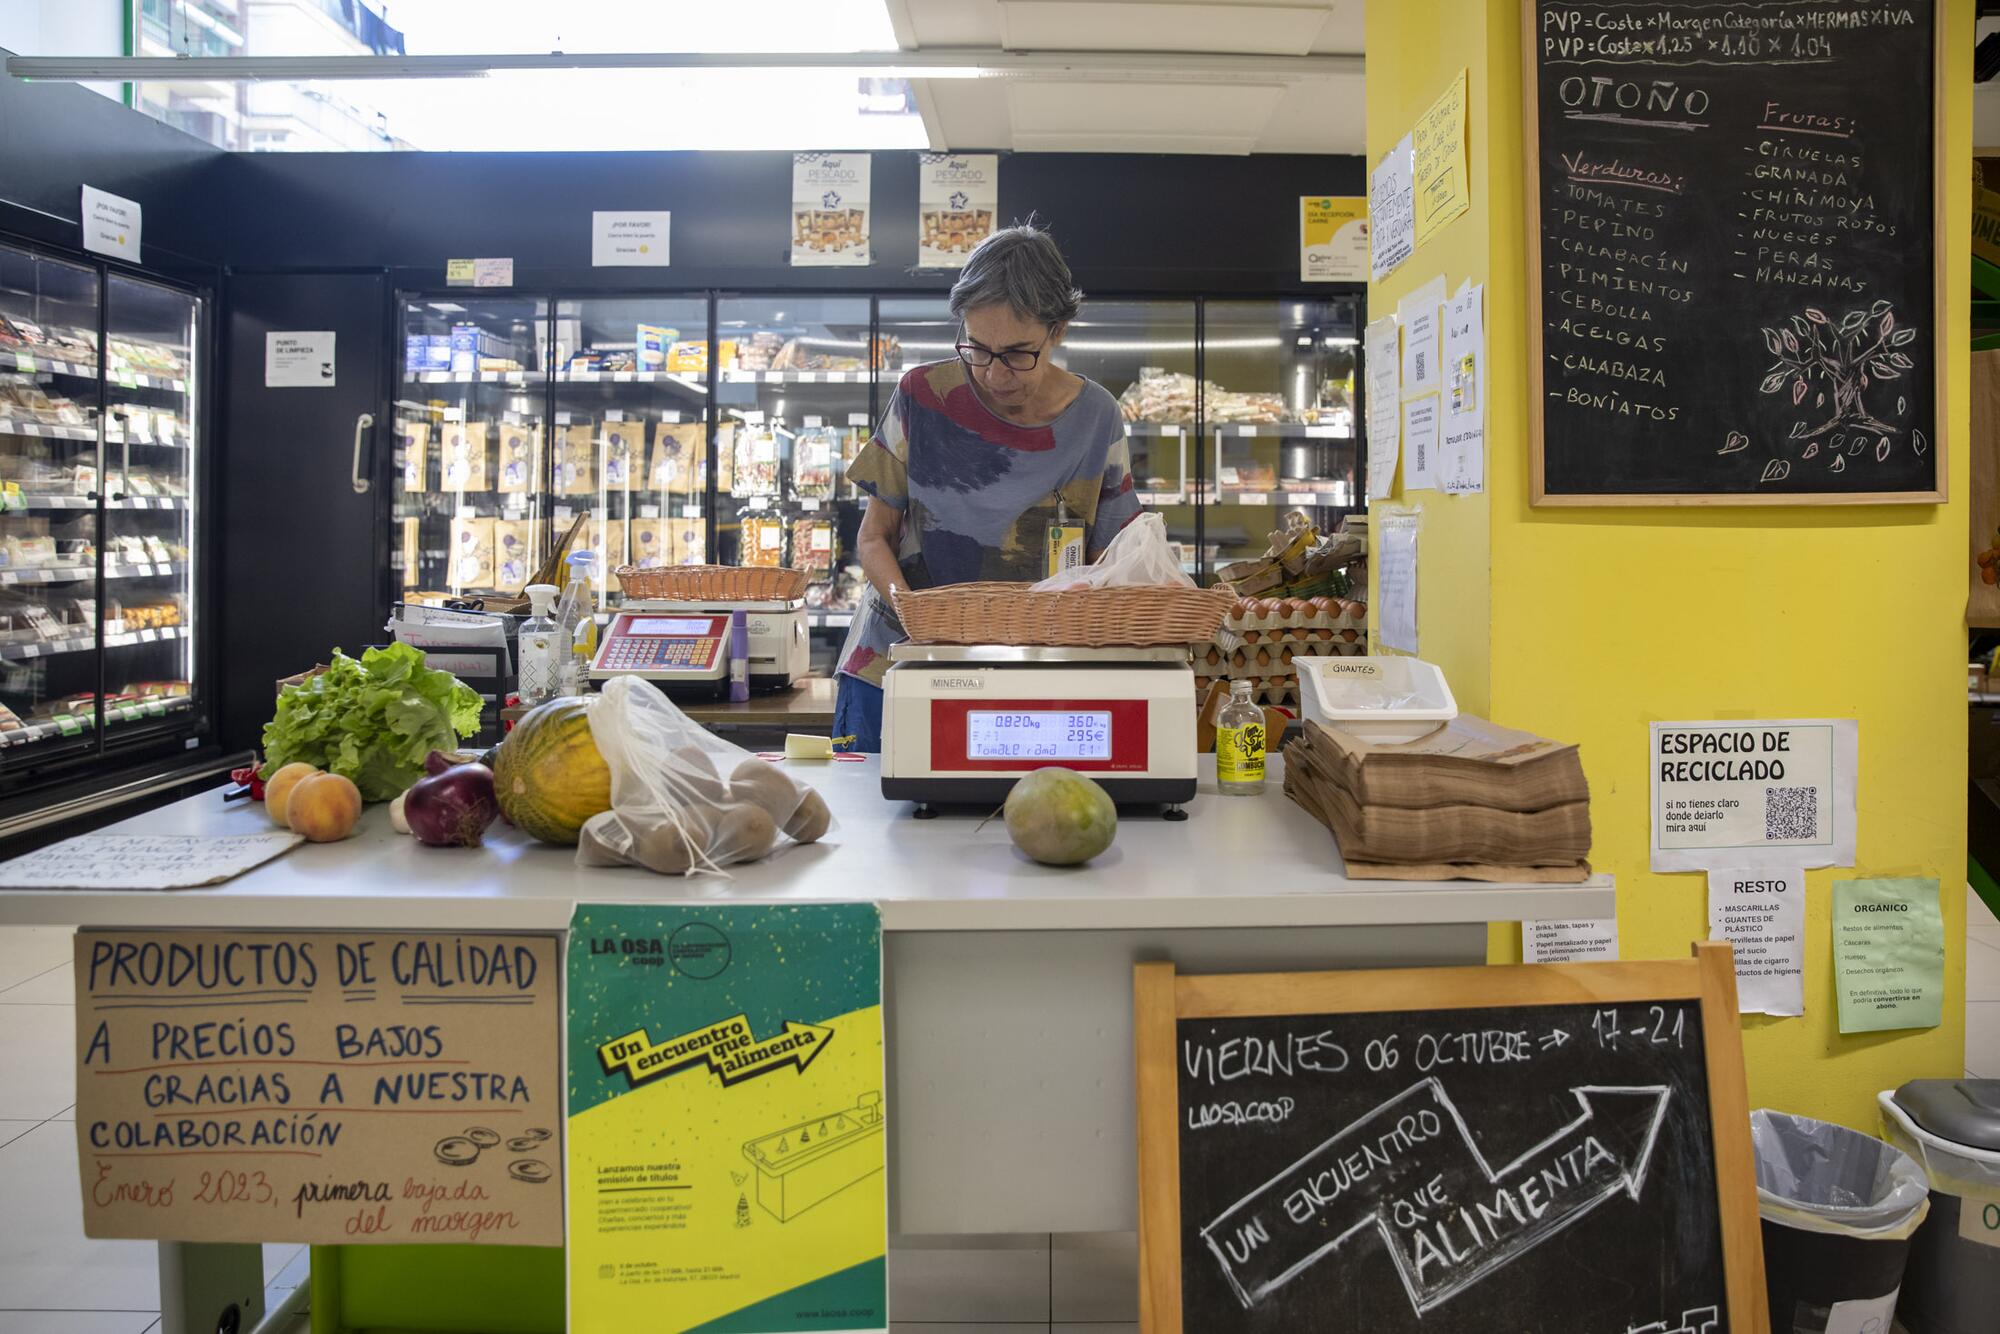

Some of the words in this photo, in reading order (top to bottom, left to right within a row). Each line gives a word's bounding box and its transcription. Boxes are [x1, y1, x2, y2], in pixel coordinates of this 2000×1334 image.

[1560, 76, 1709, 115] OTOÑO
[1764, 102, 1856, 134] Frutas:
[822, 160, 841, 170] Aquí
[948, 160, 968, 170] Aquí
[1759, 138, 1862, 168] CIRUELAS
[808, 170, 855, 179] PESCADO
[935, 170, 982, 180] PESCADO
[1562, 151, 1683, 190] Verduras:
[1754, 164, 1847, 186] GRANADA
[1568, 184, 1664, 217] TOMATES
[1564, 210, 1654, 240] PEPINO
[1753, 208, 1824, 226] FRUTOS
[1837, 215, 1896, 236] ROJOS
[1754, 228, 1836, 245] NUECES
[1562, 238, 1688, 274] CALABACÍN
[1758, 246, 1833, 270] PERAS
[1561, 263, 1694, 302] PIMIENTOS
[1756, 267, 1866, 292] MANZANAS
[1561, 290, 1651, 321] CEBOLLA
[1560, 318, 1666, 352] ACELGAS
[1564, 354, 1666, 387] CALABAZA
[1333, 664, 1376, 674] GUANTES
[932, 679, 974, 688] MINERVA
[1661, 732, 1755, 754] ESPACIO
[1762, 731, 1790, 752] DE
[1662, 760, 1784, 782] RECICLADO
[1666, 800, 1673, 809] si
[1676, 800, 1686, 808] no
[1689, 799, 1715, 808] tienes
[1718, 798, 1739, 808] claro
[1666, 810, 1692, 820] donde
[1694, 810, 1724, 821] dejarlo
[1666, 822, 1686, 832] mira
[1688, 822, 1706, 834] aquí
[1734, 880, 1786, 893] RESTO
[1725, 904, 1780, 912] MASCARILLAS
[1725, 915, 1762, 924] GUANTES
[590, 938, 616, 956] LA
[622, 938, 664, 955] OSA
[1775, 935, 1795, 943] papel
[88, 940, 317, 992] PRODUCTOS
[336, 941, 377, 988] DE
[392, 937, 537, 990] CALIDAD
[632, 956, 665, 968] coop
[1764, 957, 1789, 965] cigarro
[1774, 967, 1801, 976] higiene
[84, 1020, 110, 1066] A
[152, 1018, 296, 1062] PRECIOS
[336, 1024, 444, 1060] BAJOS
[609, 1039, 643, 1062] Un
[636, 1022, 744, 1072] encuentro
[712, 1034, 752, 1058] que
[724, 1030, 817, 1074] alimenta
[1184, 1027, 1350, 1084] VIERNES
[1364, 1040, 1398, 1072] 06
[1415, 1028, 1532, 1073] OCTUBRE
[144, 1068, 291, 1108] GRACIAS
[320, 1072, 344, 1106] A
[374, 1072, 530, 1106] NUESTRA
[90, 1113, 342, 1149] COLABORACIÓN
[598, 1165, 644, 1175] Lanzamos
[646, 1163, 681, 1173] nuestra
[598, 1174, 634, 1185] emisión
[636, 1173, 647, 1182] de
[649, 1172, 679, 1182] títulos
[1282, 1109, 1442, 1230] ENCUENTRO
[93, 1162, 176, 1207] Enero
[194, 1170, 280, 1208] 2023,
[292, 1173, 394, 1219] primera
[402, 1176, 490, 1210] bajada
[1392, 1173, 1448, 1229] QUE
[1411, 1134, 1616, 1284] ALIMENTA
[345, 1205, 392, 1236] del
[410, 1208, 520, 1244] margen
[1226, 1215, 1270, 1264] UN
